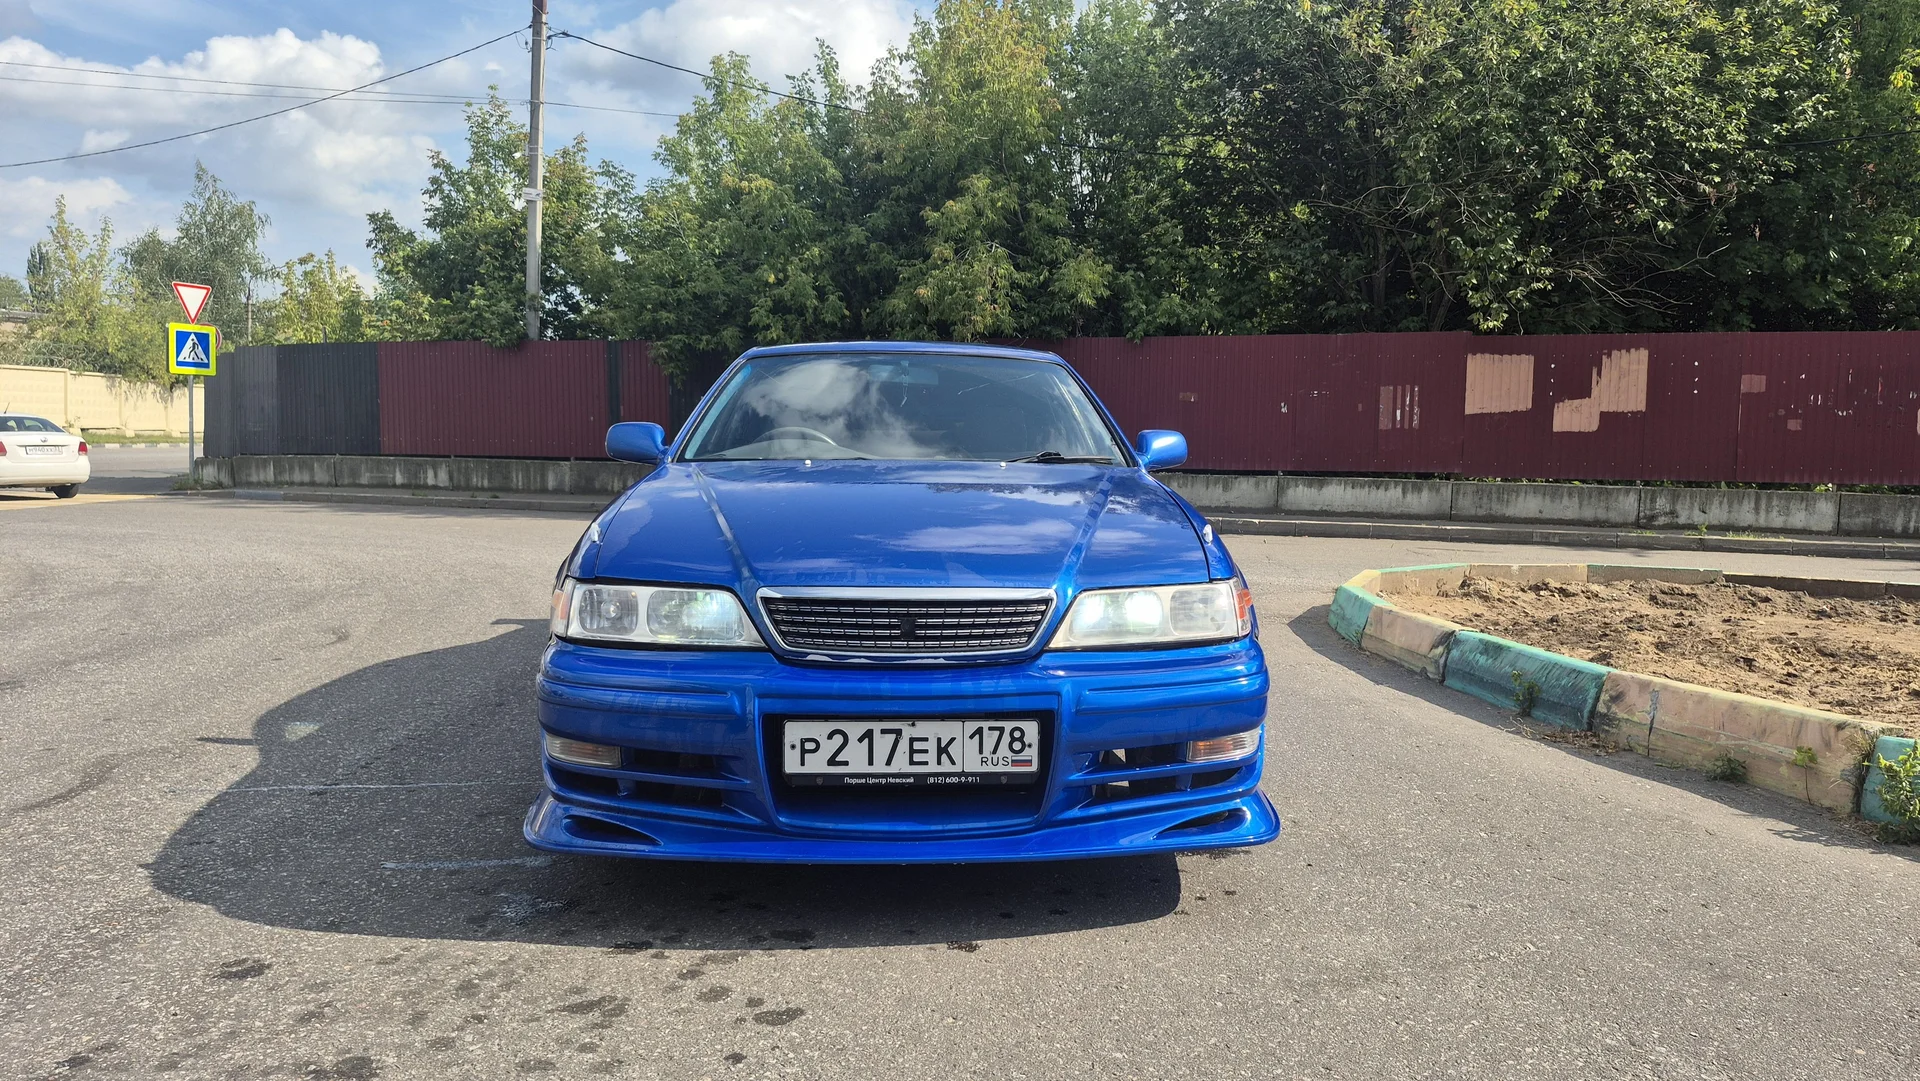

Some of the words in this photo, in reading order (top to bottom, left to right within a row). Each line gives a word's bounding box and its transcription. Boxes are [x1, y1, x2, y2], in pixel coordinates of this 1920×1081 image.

[968, 726, 1027, 755] 178
[800, 728, 957, 766] Р217ЕК
[980, 756, 1010, 767] RUS
[844, 776, 866, 785] Порше
[866, 776, 887, 785] Центр
[887, 776, 915, 784] Невский
[926, 776, 945, 785] (812)
[945, 776, 980, 784] 600-9-911
